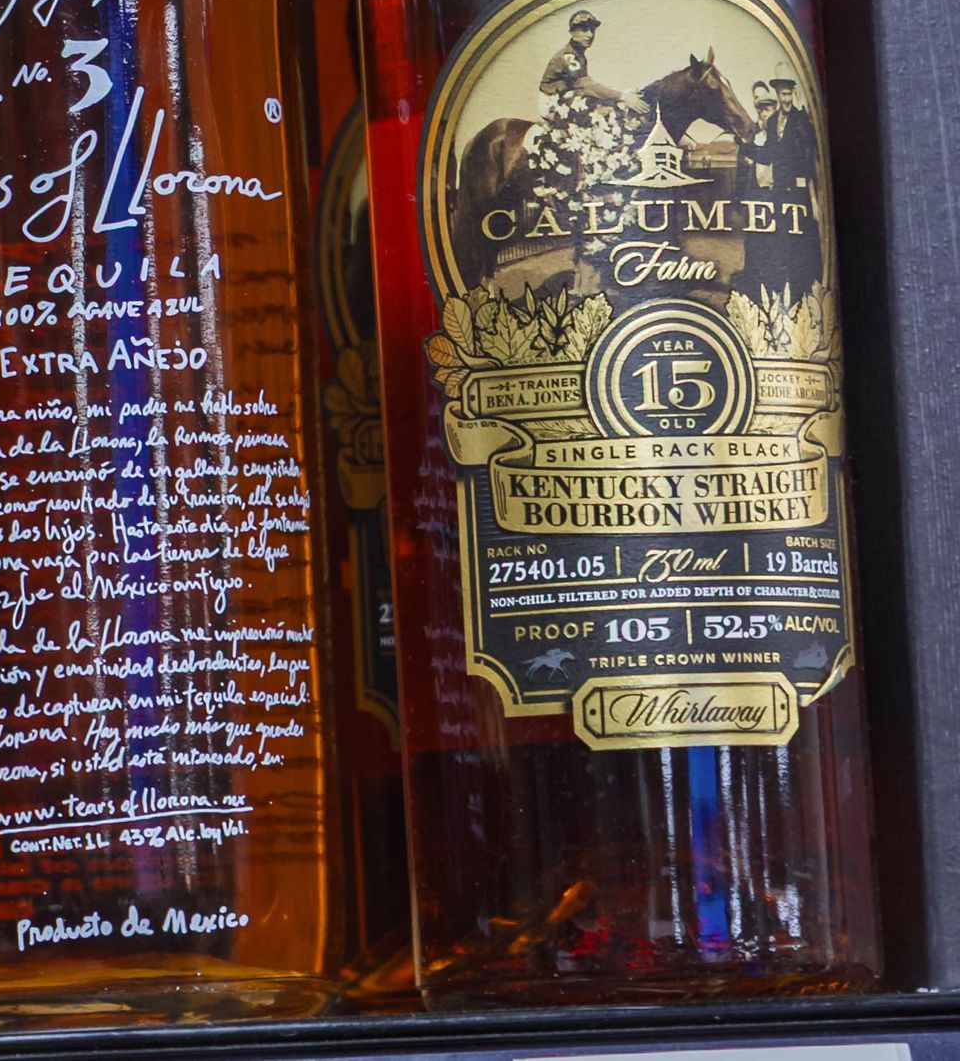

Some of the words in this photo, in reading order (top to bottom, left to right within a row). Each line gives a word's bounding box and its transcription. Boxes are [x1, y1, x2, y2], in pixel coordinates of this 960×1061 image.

[12, 61, 52, 87] No.
[61, 38, 113, 113] 3
[22, 130, 98, 242] of
[93, 86, 283, 234] Llorona
[482, 199, 808, 241] CALUMET
[609, 240, 718, 288] Farm
[67, 300, 141, 320] AGAVE
[147, 299, 204, 317] AZUL
[0, 346, 99, 378] EXTRA
[107, 336, 207, 371] AÑEJO
[652, 340, 695, 353] YEAR
[519, 377, 578, 391] TRAINER
[632, 359, 717, 412] 15
[761, 373, 800, 384] JOCKEY
[24, 398, 78, 424] niño,
[86, 399, 112, 417] mi
[119, 397, 168, 425] padre
[244, 388, 279, 416] sobre
[486, 394, 514, 408] BEN
[517, 393, 530, 406] A.
[533, 389, 580, 407] JONES
[659, 418, 696, 430] OLD
[9, 434, 35, 457] de
[68, 426, 143, 457] Llorona,
[145, 427, 169, 447] la
[545, 445, 637, 463] SINGLE
[653, 441, 716, 459] RACK
[728, 442, 792, 458] BLACK
[121, 459, 145, 478] de
[149, 465, 172, 478] un
[506, 472, 685, 501] KENTUCKY
[693, 466, 819, 499] STRAIGHT
[137, 483, 157, 507] de
[161, 492, 178, 509] su
[521, 500, 685, 528] BOURBON
[692, 495, 814, 527] WHISKEY
[165, 515, 199, 534] este
[240, 510, 257, 532] el
[487, 546, 522, 558] RACK
[527, 543, 548, 555] NO
[785, 536, 818, 548] BATCH
[819, 538, 837, 549] SIZE
[31, 555, 81, 584] vaga
[86, 550, 120, 581] por
[221, 536, 244, 559] de
[489, 555, 606, 584] 275401.05
[692, 548, 729, 571] ml
[766, 551, 786, 572] 19
[790, 551, 839, 575] Barrels
[12, 570, 54, 630] fue
[61, 570, 86, 599] el
[89, 573, 168, 600] México
[490, 593, 556, 608] NON-CHILL
[558, 589, 618, 603] FILTERED
[621, 588, 647, 600] FOR
[649, 587, 691, 598] ADDED
[694, 586, 734, 598] DEPTH
[736, 586, 752, 597] OF
[32, 627, 61, 654] de
[66, 619, 96, 654] la
[99, 614, 181, 656] Llorona
[514, 621, 595, 642] PROOF
[604, 617, 672, 643] 105
[703, 614, 784, 640] 52.5%
[784, 615, 840, 634] ALC/VOL
[588, 654, 648, 669] TRIPLE
[654, 652, 716, 666] CROWN
[722, 651, 781, 664] WINNER
[35, 665, 48, 698] y
[13, 693, 41, 719] de
[127, 693, 154, 710] en
[155, 689, 184, 707] mi
[181, 679, 247, 715] tequila
[608, 689, 769, 732] Whirlaway
[83, 714, 123, 758] Hay
[124, 715, 181, 740] mucho
[224, 721, 252, 747] que
[49, 757, 66, 778] si
[70, 744, 125, 773] usted
[127, 746, 168, 768] está
[84, 831, 110, 851] 1L
[119, 825, 166, 848] 43%
[199, 823, 223, 845] by
[221, 818, 250, 837] Vol.
[17, 911, 113, 952] Producto
[120, 904, 155, 938] de
[161, 905, 250, 936] Mexico
